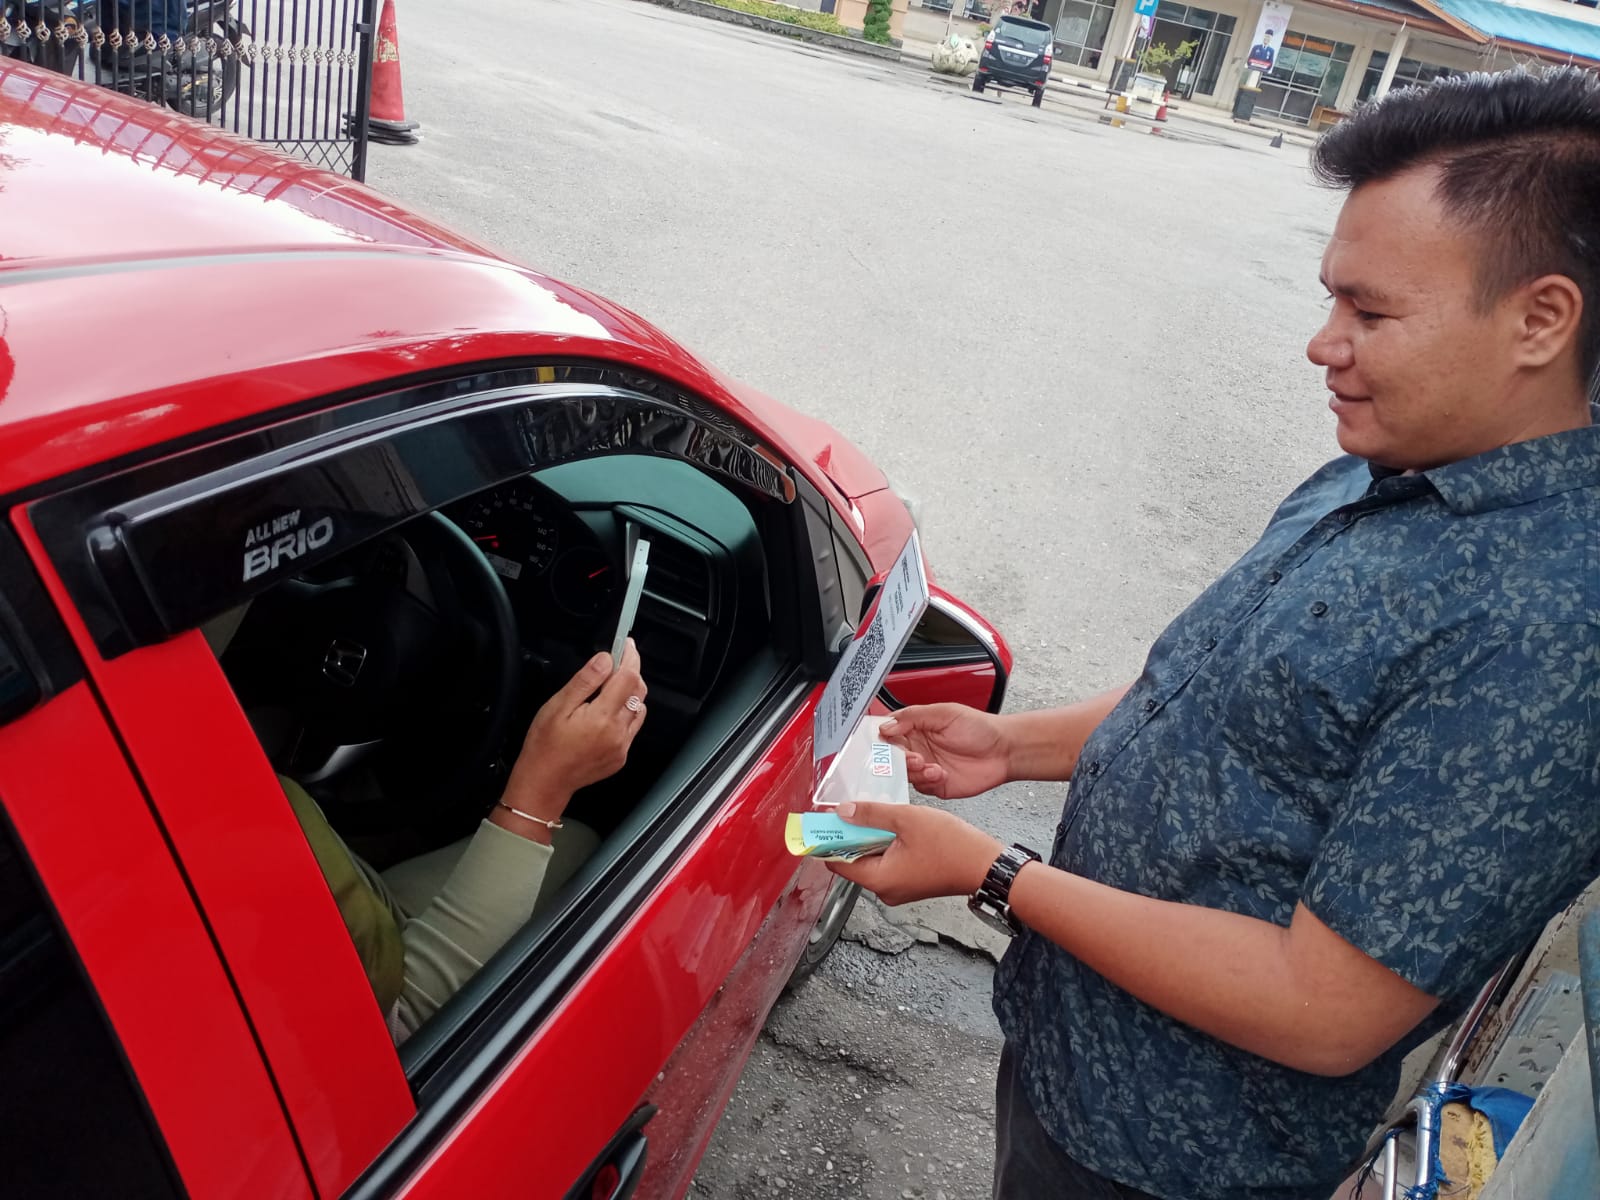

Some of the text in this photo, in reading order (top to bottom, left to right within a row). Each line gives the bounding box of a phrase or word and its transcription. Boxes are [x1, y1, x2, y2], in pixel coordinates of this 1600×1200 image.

[1138, 0, 1155, 11] P
[244, 508, 302, 548] ALL NEW
[242, 516, 334, 583] BRIO
[873, 743, 889, 764] BNI
